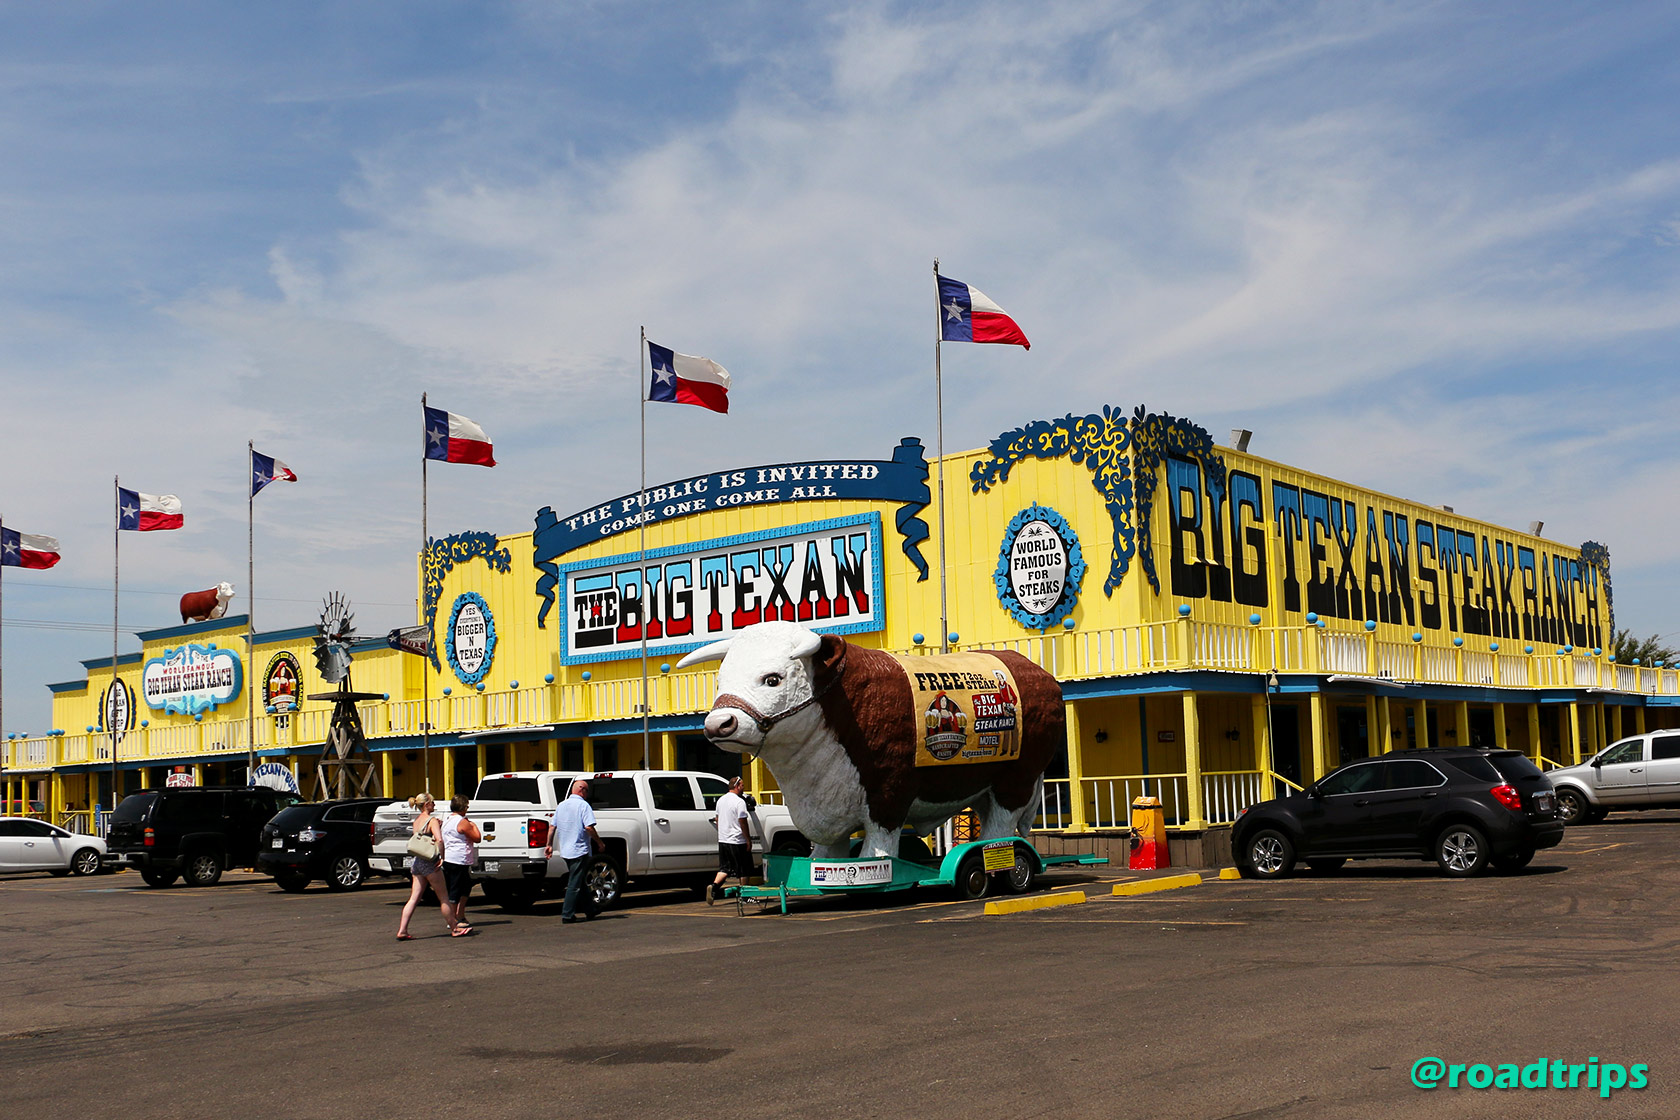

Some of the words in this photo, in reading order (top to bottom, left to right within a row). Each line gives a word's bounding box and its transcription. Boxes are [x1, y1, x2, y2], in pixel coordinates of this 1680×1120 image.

[565, 505, 613, 532] THE
[621, 478, 708, 513] PUBLIC
[719, 471, 746, 489] IS
[757, 464, 880, 484] INVITED
[599, 509, 656, 536] COME
[662, 499, 707, 517] ONE
[715, 488, 780, 507] COME
[792, 485, 837, 499] ALL
[1016, 538, 1056, 555] WORLD
[1166, 453, 1269, 608] BIG
[1271, 478, 1415, 627] TEXAN
[1415, 518, 1520, 640] STEAK
[1518, 546, 1601, 648] RANCH
[1014, 553, 1061, 570] FAMOUS
[1028, 569, 1049, 580] FOR
[574, 591, 617, 630] THE
[616, 558, 694, 643] BIG
[700, 532, 869, 633] TEXAN
[1019, 580, 1060, 597] STEAKS
[457, 623, 484, 636] BIGGER
[467, 636, 474, 646] 'N
[459, 648, 483, 660] TEXAS
[163, 665, 185, 675] WORLD
[187, 662, 215, 673] FAMOUS
[147, 678, 160, 696] BIG
[161, 674, 181, 693] TEXAN
[183, 671, 205, 691] STEAK
[206, 667, 232, 688] RANCH
[914, 672, 965, 691] FREE
[966, 680, 997, 690] STEAK
[980, 695, 996, 705] BIG
[976, 704, 1003, 716] TEXAN
[974, 720, 998, 730] STEAK
[998, 718, 1015, 728] RANCH
[980, 736, 999, 745] MOTEL
[256, 763, 281, 778] TEXAN
[826, 868, 846, 882] BIG
[859, 864, 890, 881] TEXAN
